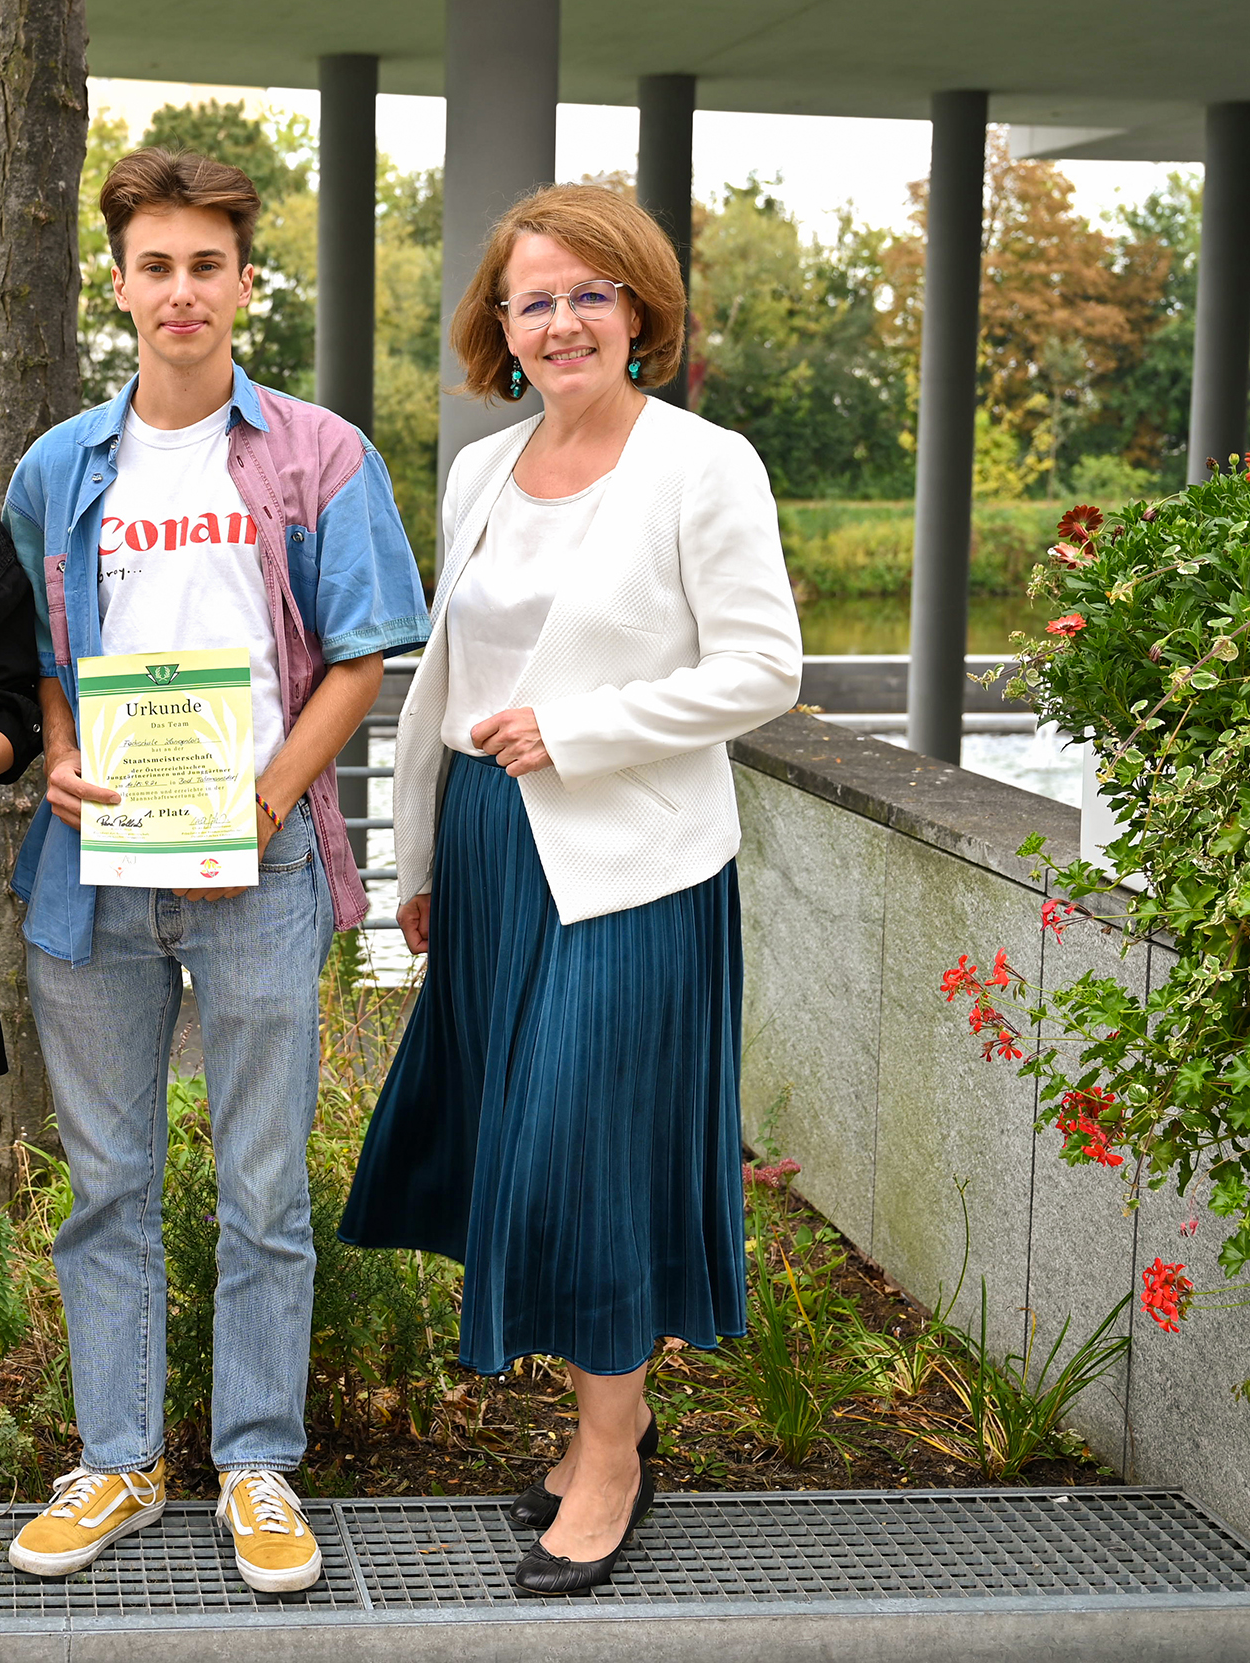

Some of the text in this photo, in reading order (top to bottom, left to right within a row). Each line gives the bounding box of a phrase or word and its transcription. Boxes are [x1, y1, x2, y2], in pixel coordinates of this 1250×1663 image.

[97, 511, 257, 556] Conan
[126, 698, 203, 717] Urkunde
[122, 753, 213, 765] Staatsmeisterschaft
[145, 764, 206, 773] Österreichischen
[106, 773, 170, 781] Junggärtnerinnen
[187, 768, 231, 777] Junggärtner
[174, 786, 204, 794] erreichte
[130, 792, 196, 802] Mannschaftswertung
[144, 808, 190, 818] 1. Platz
